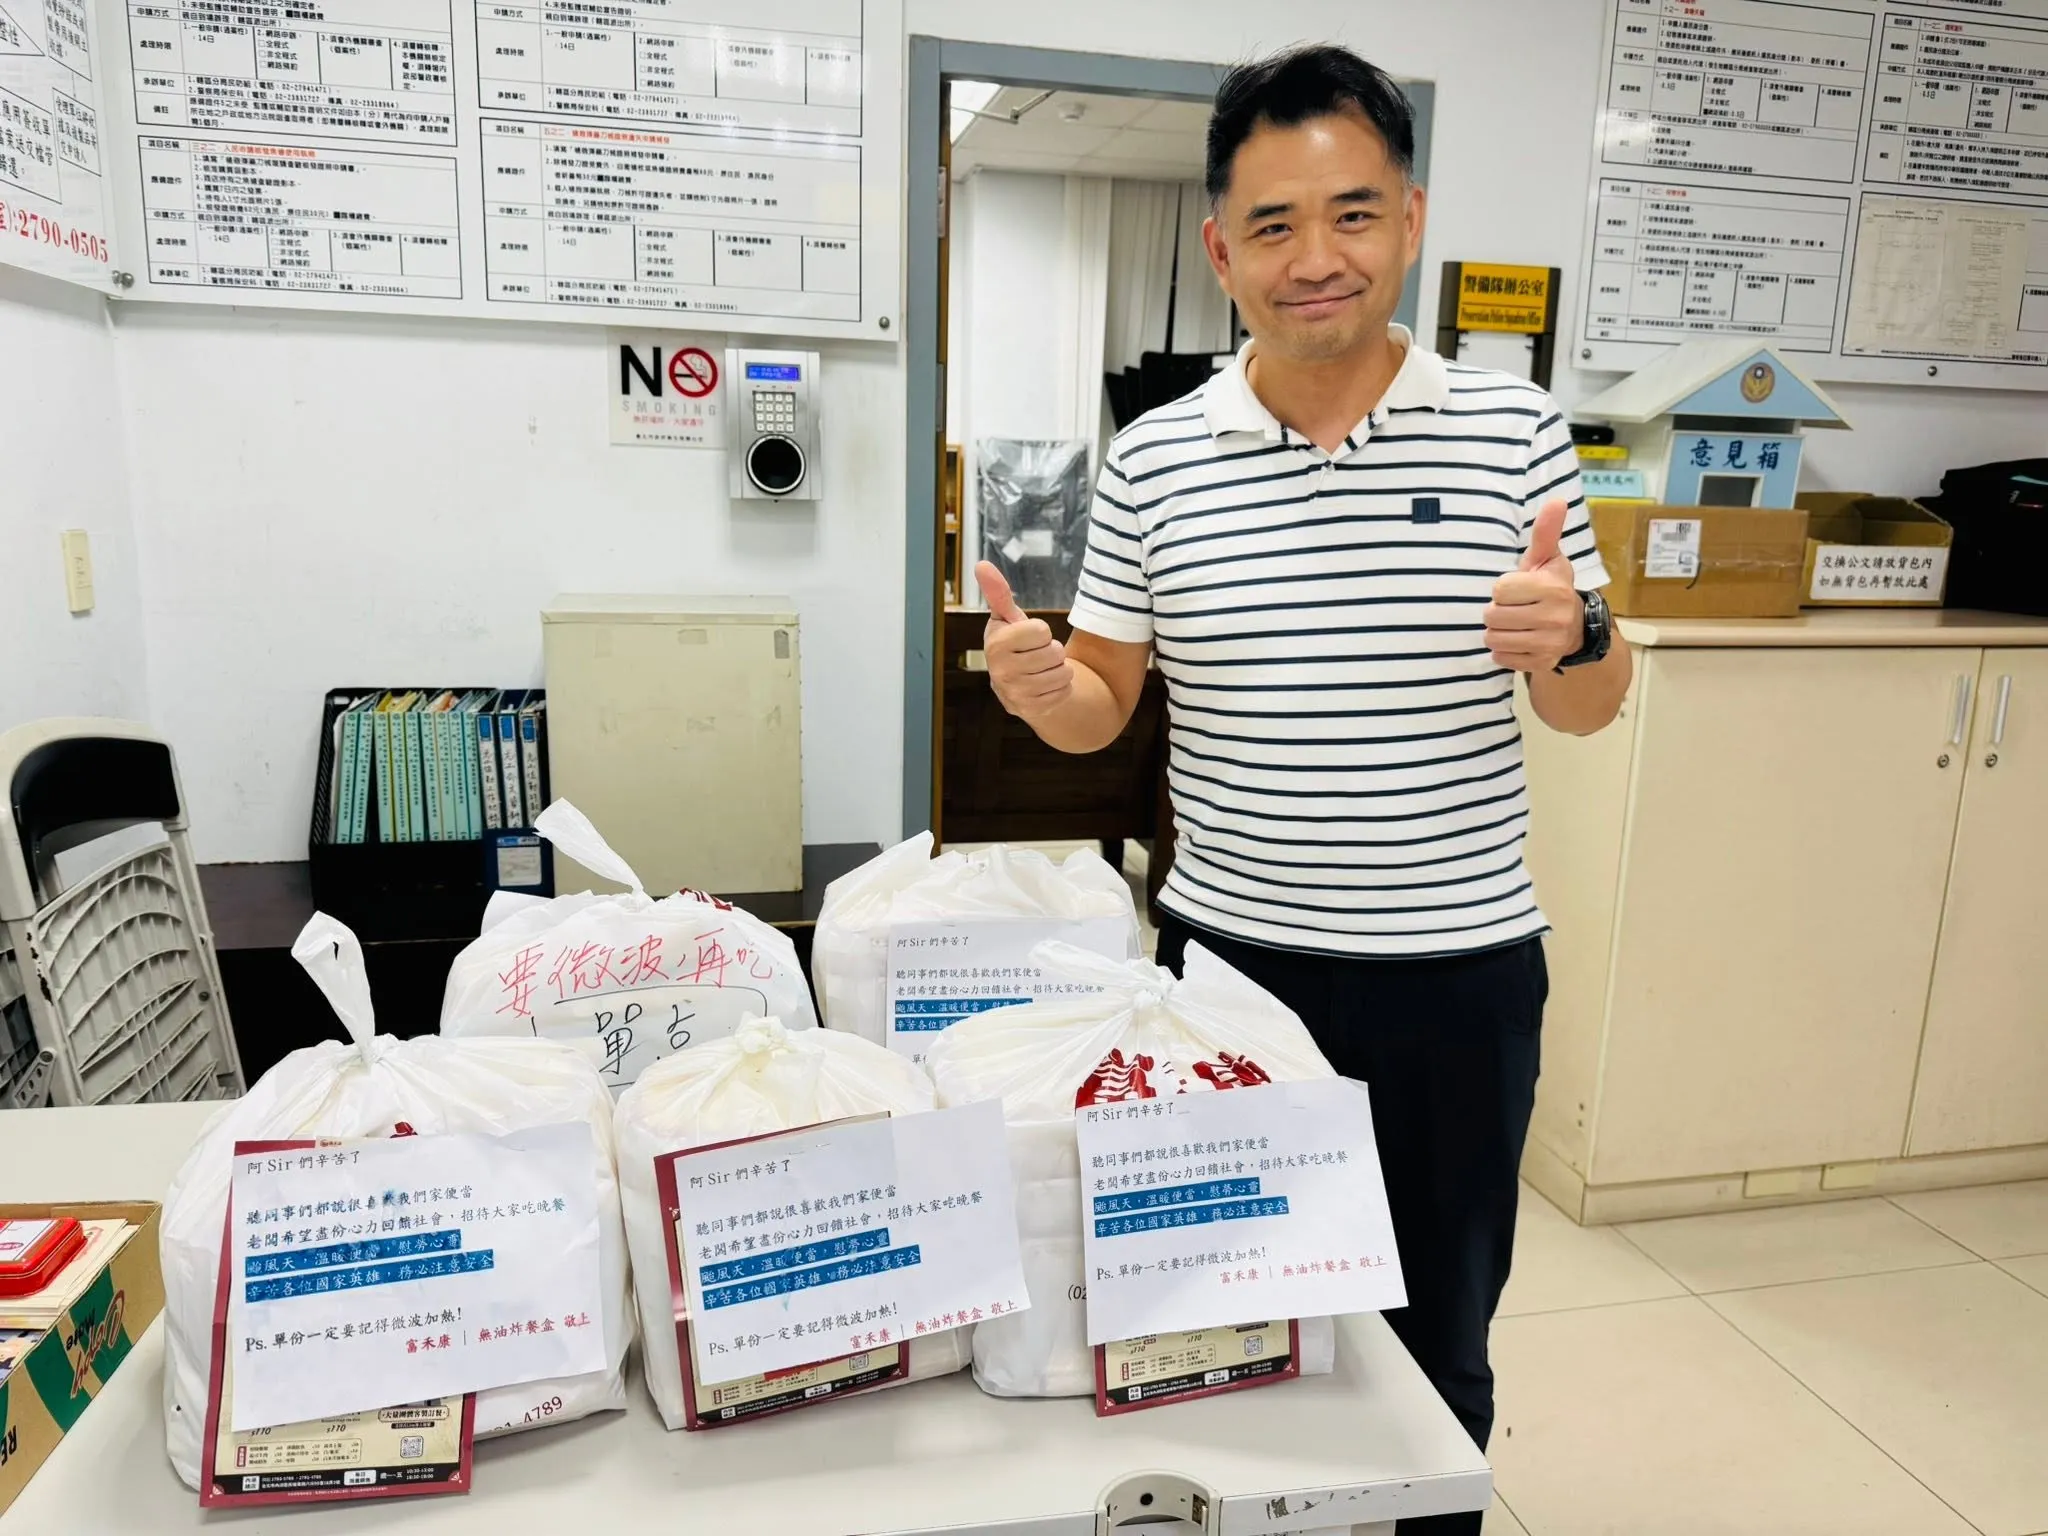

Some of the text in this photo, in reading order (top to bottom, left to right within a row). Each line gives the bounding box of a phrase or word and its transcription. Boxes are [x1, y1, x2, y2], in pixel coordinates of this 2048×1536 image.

[1690, 437, 1782, 471] 意見箱
[1821, 555, 1933, 570] 交換公文請放背包內
[896, 936, 969, 948] 阿 Sir 們辛苦了
[1087, 1101, 1174, 1123] 阿 Sir 們辛苦了
[247, 1151, 360, 1174] 阿 Sir 們辛苦了
[1092, 1136, 1269, 1169] 聽同事們都說很喜歡我們家便當
[689, 1158, 791, 1190] 阿 Sir 們辛苦了
[1093, 1151, 1349, 1191] 老闆希望盡份心力回饋社會,招待大家吃晚餐
[246, 1197, 566, 1249] 老闆希望盡份心力回饋社會,招待大家吃晚餐
[696, 1184, 898, 1237] 聽同事們都說很喜歡我們家便當
[698, 1190, 984, 1260] 老闆希望盡份心力回饋社會,招待大家吃晚餐
[1097, 1246, 1268, 1280] Ps. 單份一定要記得微波加熱!
[1219, 1254, 1387, 1284] 富禾康 無油炸餐盒 敬上
[244, 1308, 463, 1352] Ps. 單份一定要記得微波加熱!
[405, 1310, 591, 1355] 富禾康 無油炸餐盒 敬上
[708, 1302, 899, 1356] Ps. 單份一定要記得微波加熱!
[849, 1299, 1019, 1350] 富禾康 無油炸餐盒 敬上
